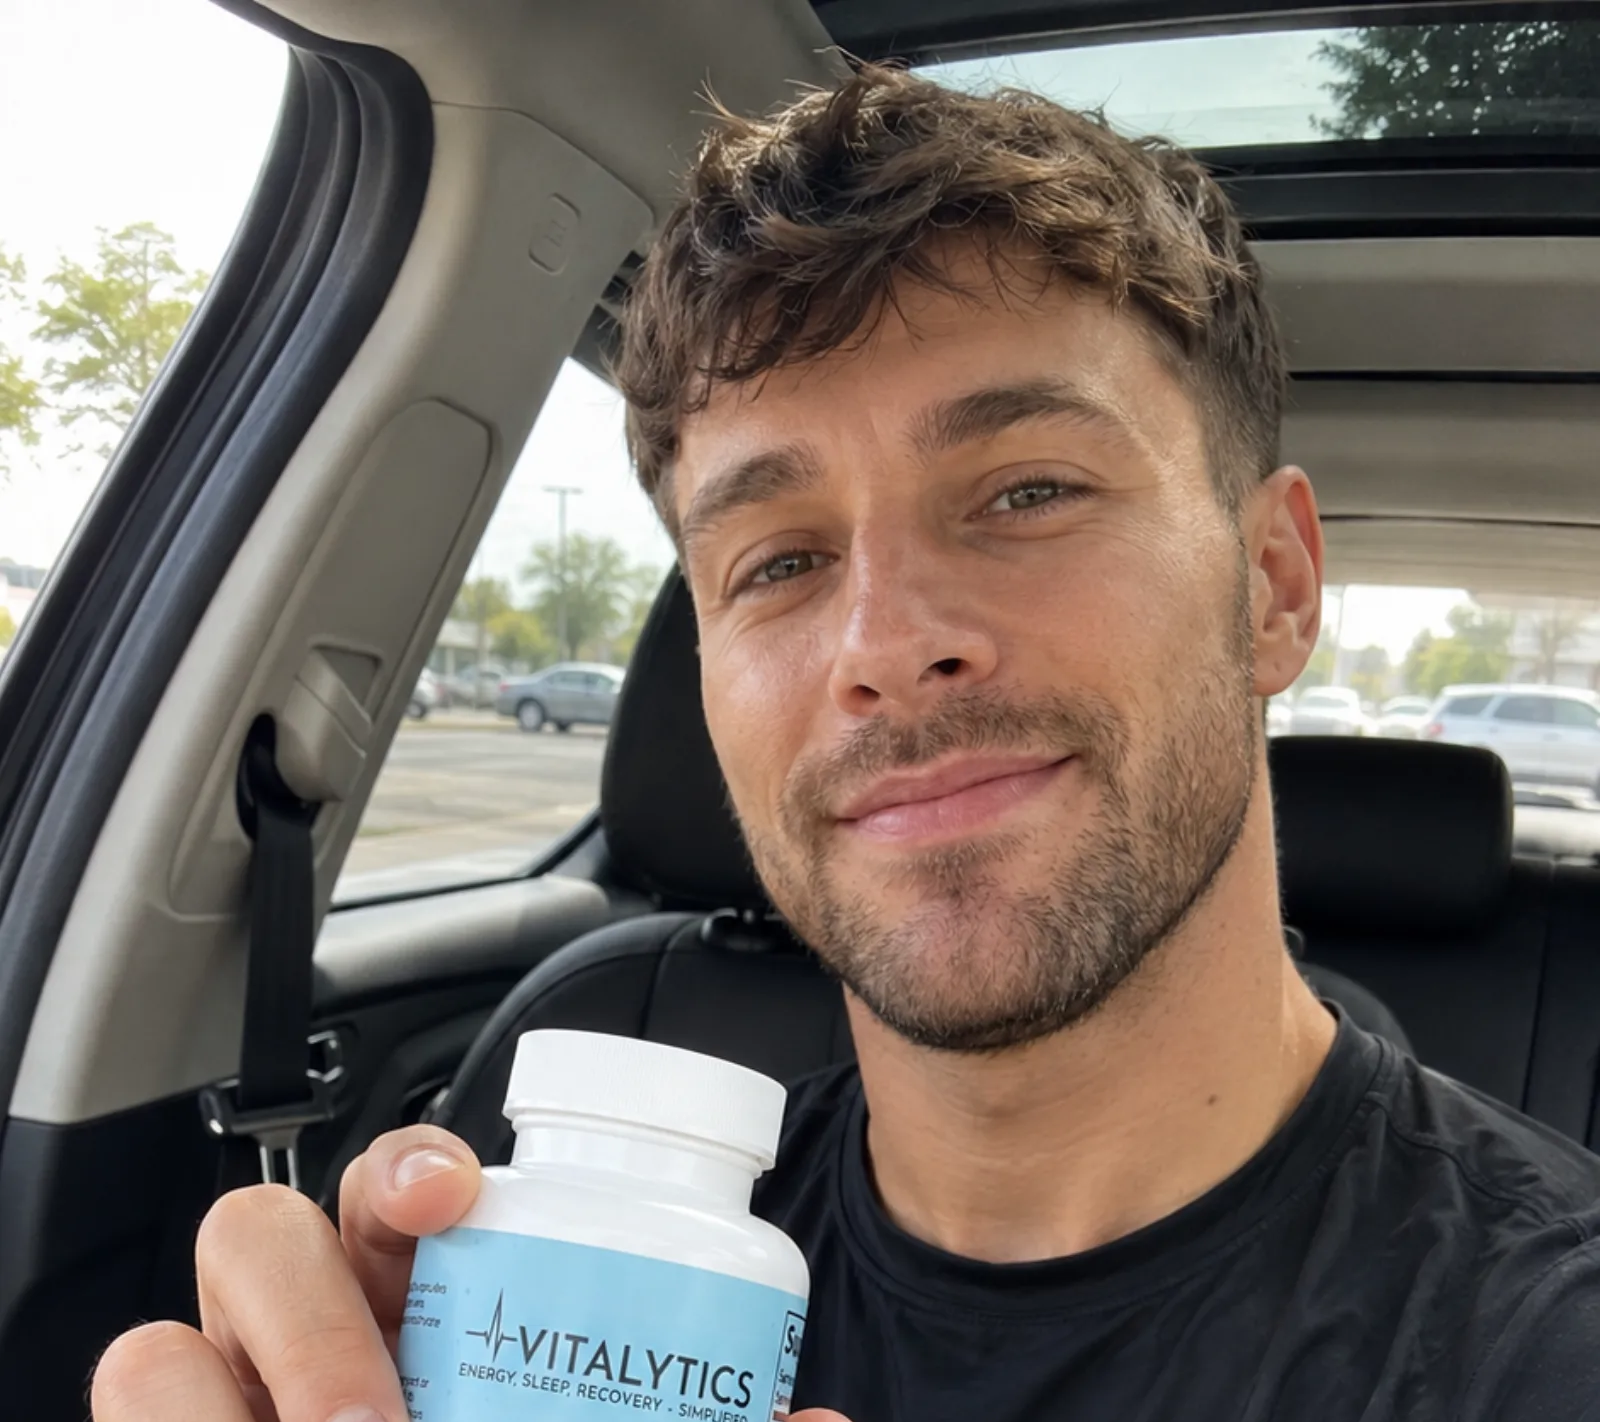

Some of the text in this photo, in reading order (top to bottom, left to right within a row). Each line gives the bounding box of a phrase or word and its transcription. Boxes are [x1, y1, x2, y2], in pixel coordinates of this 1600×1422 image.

[458, 1361, 518, 1388] ENERGY,
[521, 1373, 572, 1398] SLEEP,
[576, 1382, 663, 1412] RECOVERY
[518, 1325, 755, 1409] VITALYTICS
